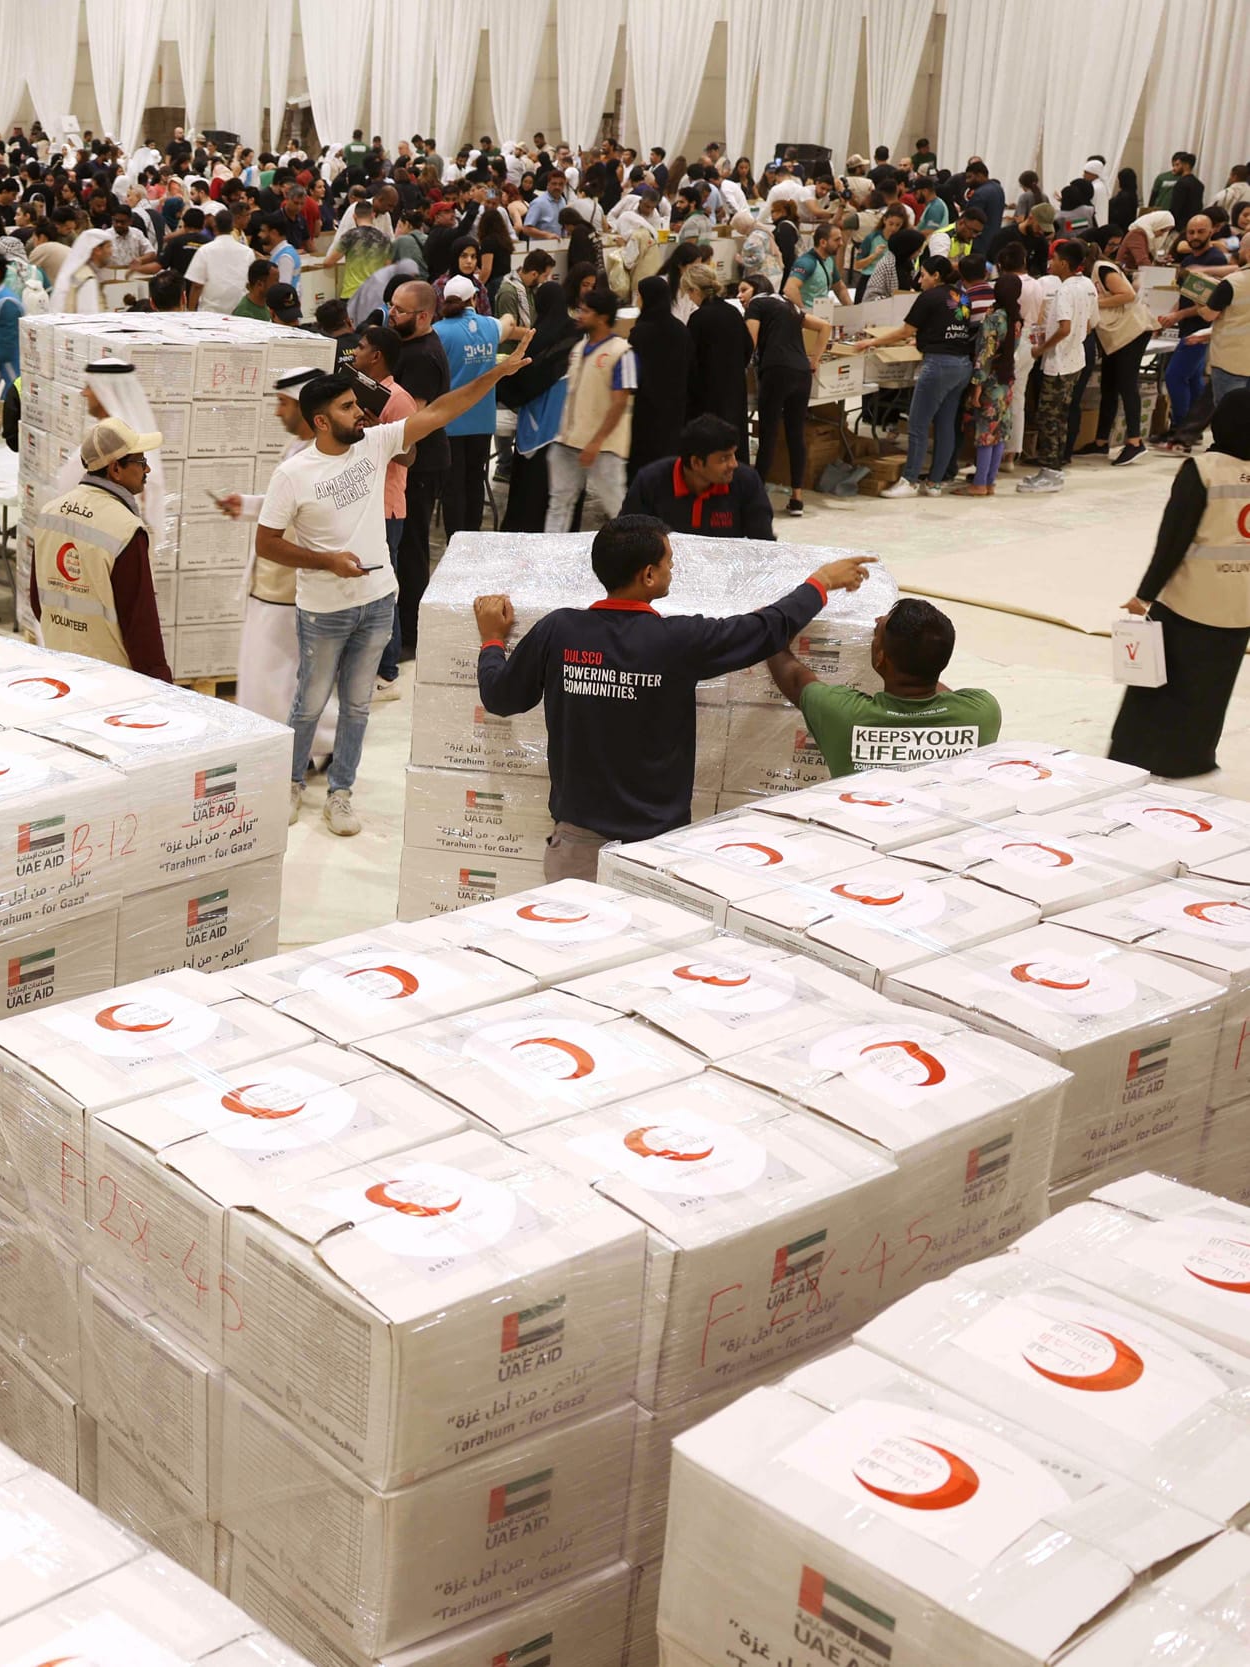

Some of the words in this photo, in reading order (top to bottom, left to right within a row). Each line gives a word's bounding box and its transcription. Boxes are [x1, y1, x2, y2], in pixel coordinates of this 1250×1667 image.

[315, 457, 375, 499] AMERICAN
[333, 479, 370, 510] EAGLE
[60, 501, 93, 519] متطوع
[51, 614, 88, 632] VOLUNTEER
[564, 648, 603, 665] DULSCO
[564, 664, 616, 682] POWERING
[620, 672, 662, 687] BETTER
[564, 679, 637, 700] COMMUNITIES.
[856, 730, 910, 743] KEEPS
[911, 730, 974, 745] YOUR
[793, 755, 813, 765] UAE
[855, 745, 906, 760] LIFE
[193, 806, 214, 822] UAE
[216, 801, 235, 816] AID
[464, 814, 484, 824] UAE
[486, 815, 502, 825] AID
[70, 814, 138, 876] B-12
[214, 848, 228, 859] for
[16, 862, 42, 876] UAE
[44, 854, 64, 869] AID
[8, 888, 28, 907] أجل
[30, 886, 46, 900] من
[458, 891, 476, 900] UAE
[42, 902, 56, 915] for
[186, 933, 206, 947] UAE
[209, 926, 227, 940] AID
[198, 956, 212, 968] من
[6, 993, 32, 1009] UAE
[33, 986, 54, 1002] AID
[859, 1213, 932, 1289] 45
[767, 1288, 795, 1311] UAE
[796, 1277, 820, 1300] AID
[498, 1357, 532, 1382] UAE
[535, 1347, 562, 1369] AID
[529, 1409, 549, 1425] for
[485, 1527, 518, 1550] UAE
[522, 1517, 549, 1537] AID
[794, 1623, 840, 1666] UAE
